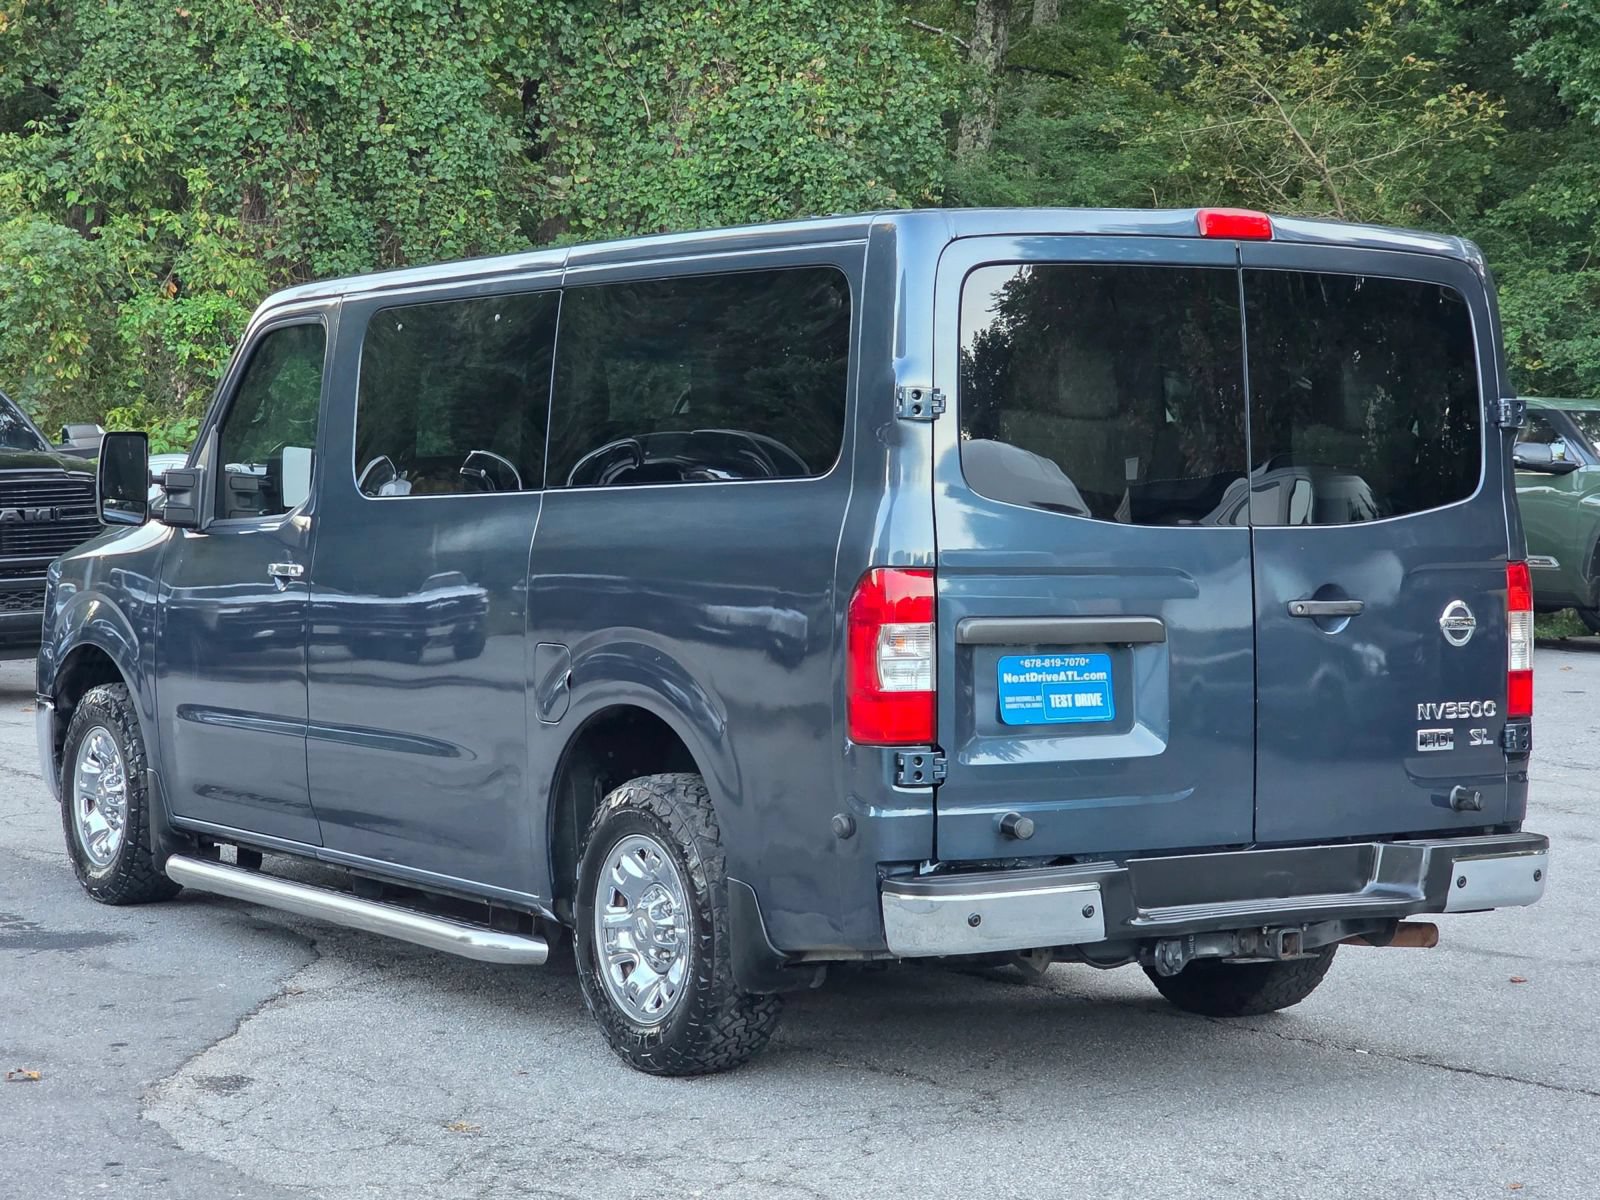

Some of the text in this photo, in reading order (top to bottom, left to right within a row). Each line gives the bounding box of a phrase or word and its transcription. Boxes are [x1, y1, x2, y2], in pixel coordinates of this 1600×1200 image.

[0, 508, 53, 521] AM
[1003, 670, 1107, 684] NextDriveATL.com
[1049, 693, 1073, 708] TEST
[1074, 692, 1104, 707] DRIVE
[1417, 700, 1497, 720] NV3500
[1469, 728, 1494, 746] SL
